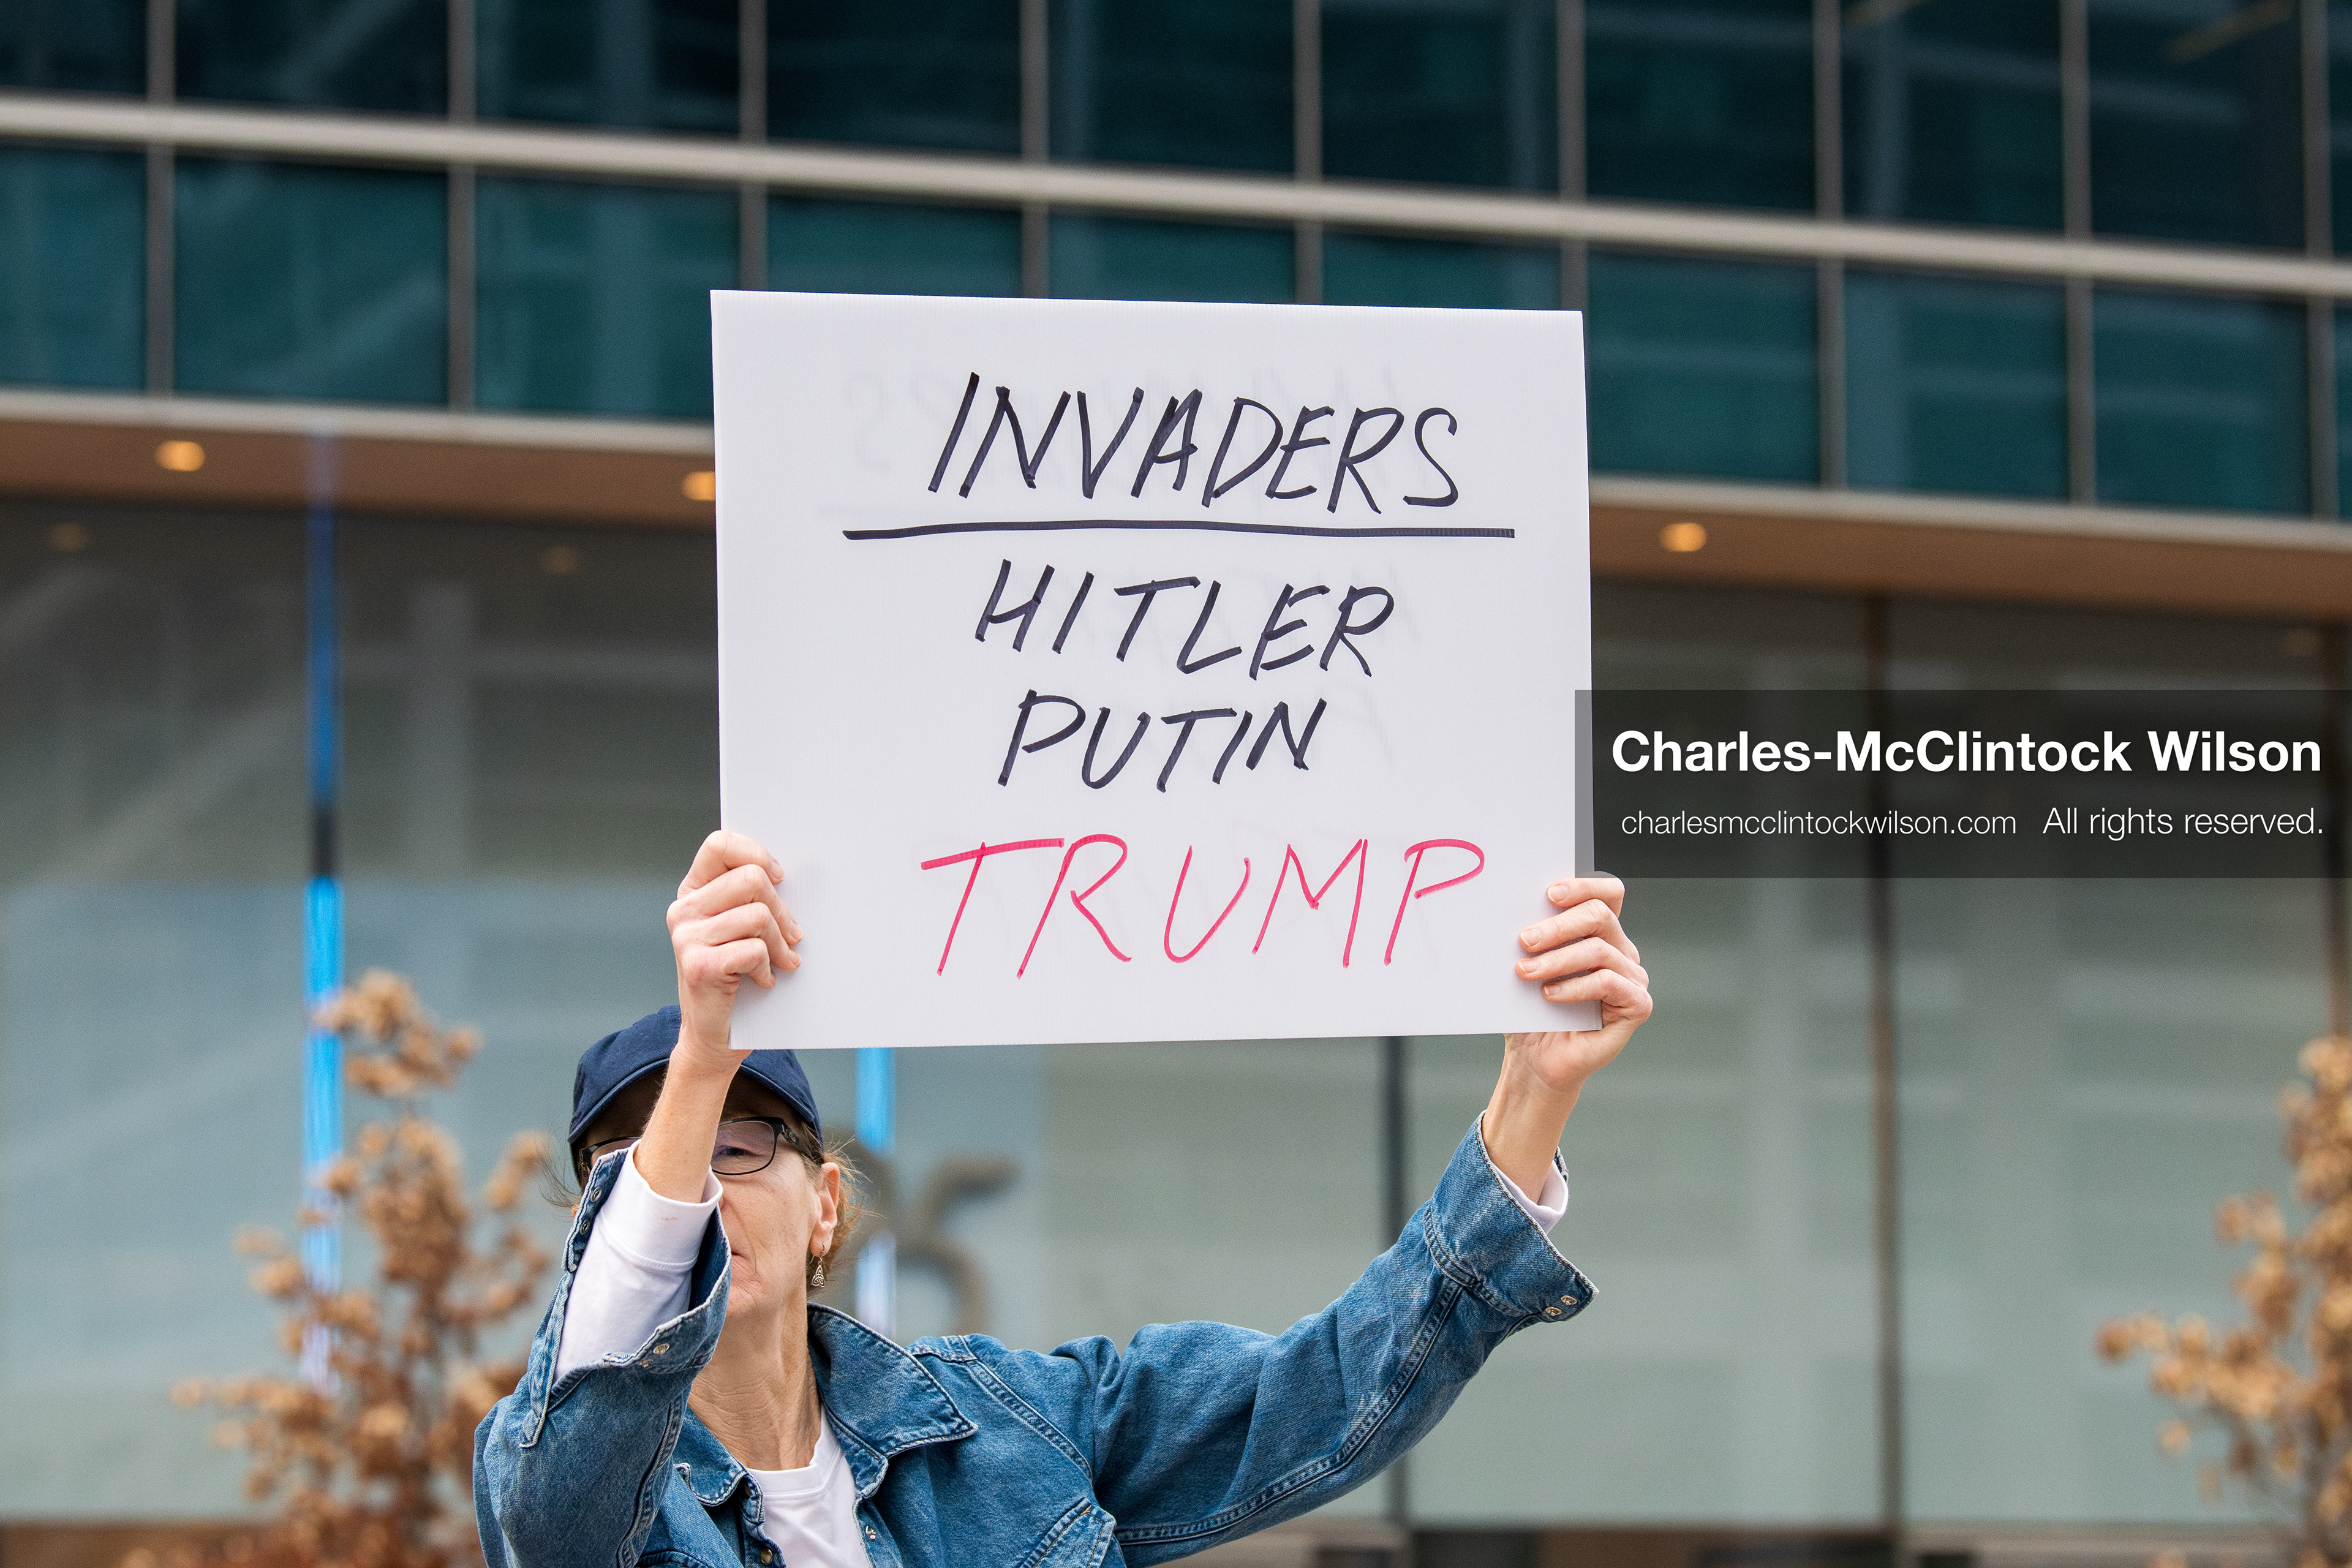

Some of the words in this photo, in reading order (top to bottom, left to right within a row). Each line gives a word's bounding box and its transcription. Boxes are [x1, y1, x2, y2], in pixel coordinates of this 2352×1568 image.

[927, 371, 1459, 514] INVADERS
[974, 559, 1395, 681] HITLER
[997, 688, 1327, 793] PUTIN
[921, 834, 1485, 979] TRUMP
